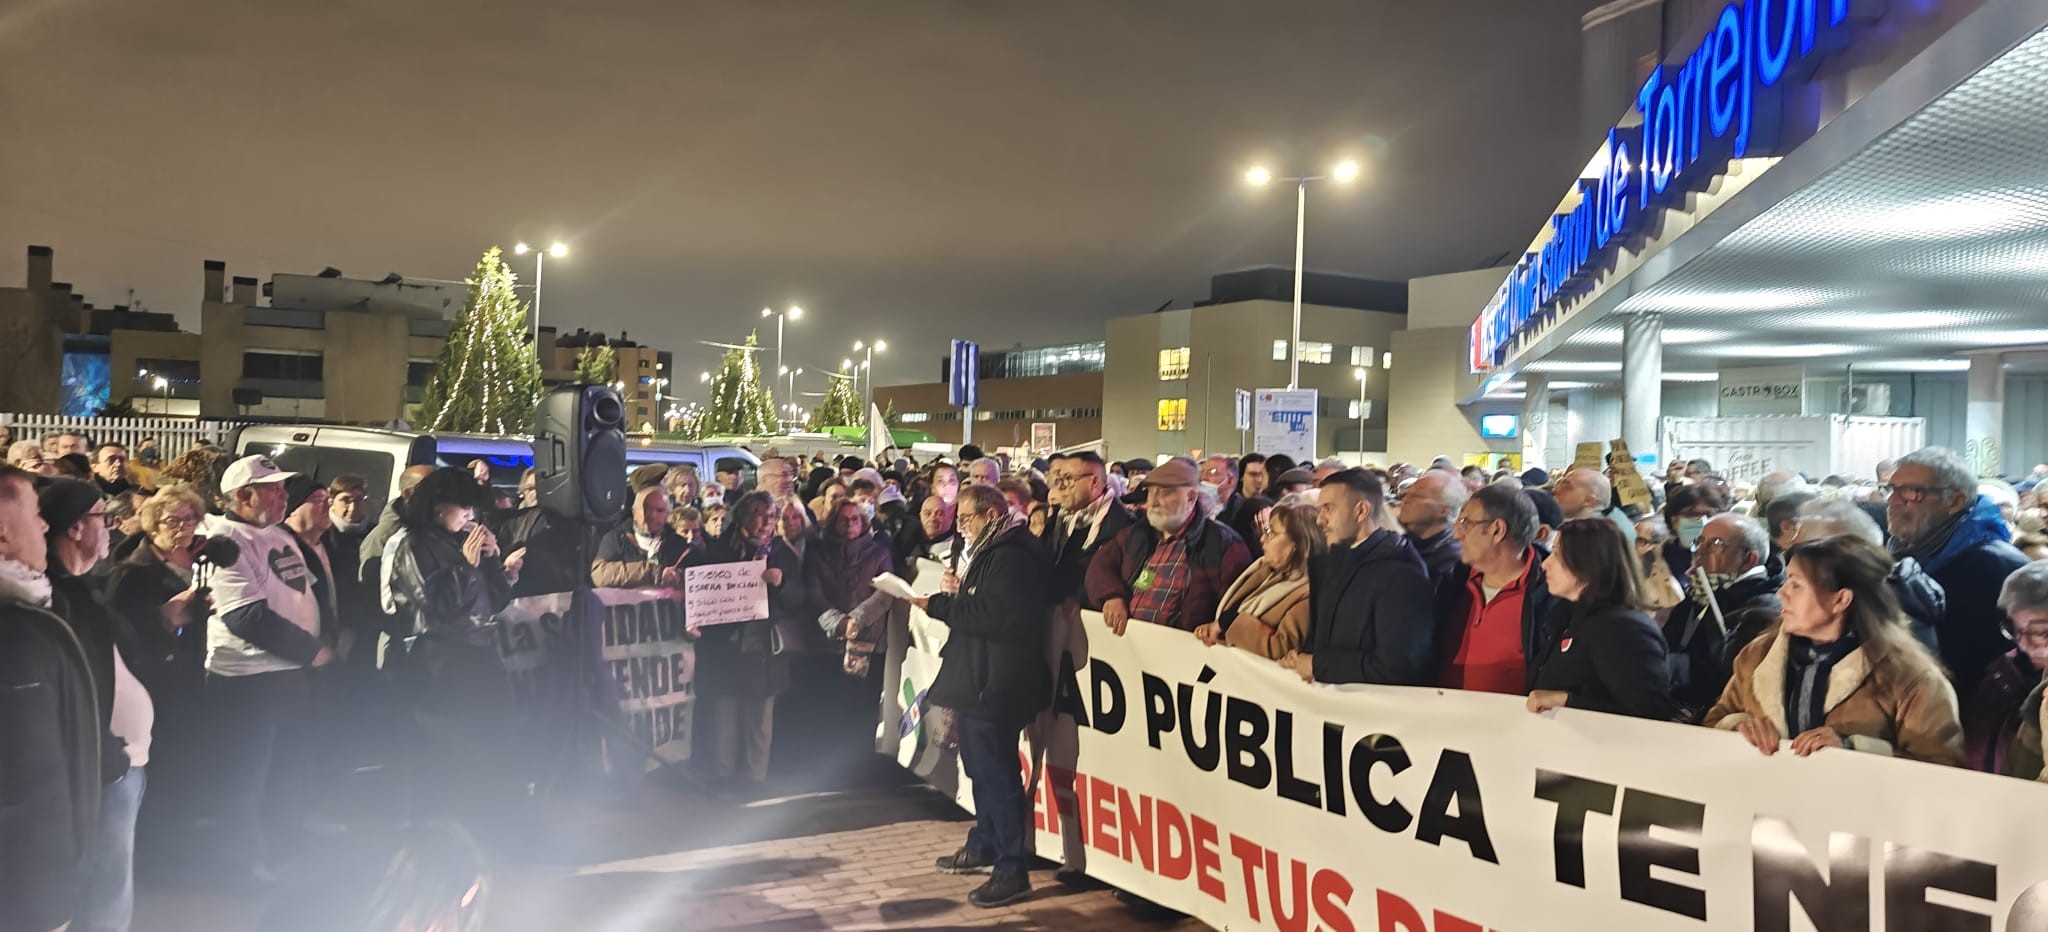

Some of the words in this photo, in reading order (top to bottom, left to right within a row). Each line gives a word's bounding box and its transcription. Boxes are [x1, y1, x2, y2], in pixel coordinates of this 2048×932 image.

[1596, 127, 1629, 249] de
[1141, 664, 1499, 865] PÚBLICA
[1534, 767, 1707, 922] TE
[1229, 832, 1355, 932] TUS
